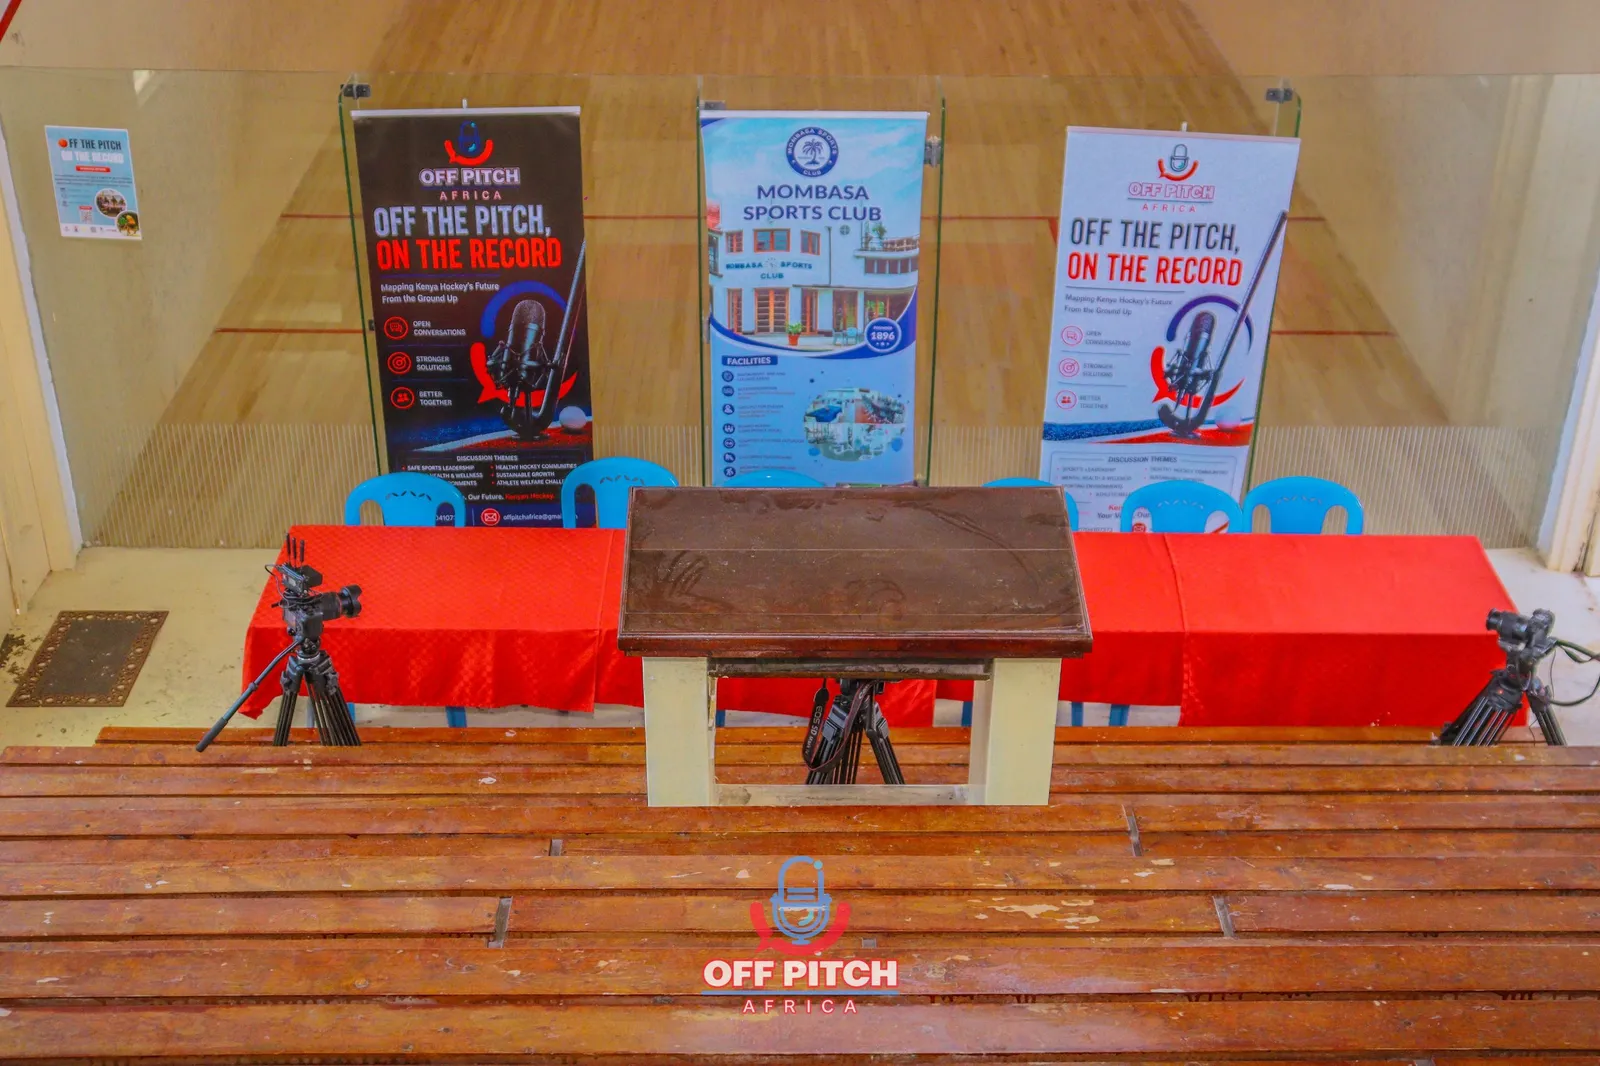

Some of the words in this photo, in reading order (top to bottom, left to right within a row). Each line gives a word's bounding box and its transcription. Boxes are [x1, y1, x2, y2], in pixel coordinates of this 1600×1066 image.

[81, 139, 96, 149] THE
[98, 140, 122, 150] PITCH
[787, 128, 815, 154] MOMBASA
[817, 128, 838, 154] SPORTS
[419, 168, 458, 186] OFF
[461, 167, 521, 186] PITCH
[440, 190, 502, 201] AFRICA
[757, 184, 869, 200] MOMBASA
[1128, 182, 1163, 197] OFF
[1164, 184, 1216, 200] PITCH
[743, 205, 822, 220] SPORTS
[828, 206, 881, 221] CLUB
[1142, 203, 1196, 213] AFRICA
[373, 206, 416, 237] OFF
[423, 205, 469, 236] THE
[475, 204, 552, 238] PITCH,
[1071, 217, 1112, 246] OFF
[1121, 220, 1162, 249] THE
[1170, 223, 1240, 254] PITCH,
[376, 239, 410, 270] ON
[416, 239, 464, 270] THE
[469, 237, 562, 269] RECORD
[780, 262, 812, 270] SPORTS
[1067, 252, 1098, 280] ON
[1107, 254, 1149, 283] THE
[1156, 256, 1243, 286] RECORD
[381, 282, 414, 292] Mapping
[415, 282, 438, 292] Kenya
[440, 282, 473, 292] Hockey's
[475, 282, 499, 291] Future
[382, 295, 401, 304] From
[402, 295, 416, 303] the
[417, 294, 445, 303] Ground
[447, 294, 458, 304] Up
[1065, 294, 1095, 303] Mapping
[1096, 295, 1117, 304] Kenya
[1119, 297, 1150, 306] Hockey's
[1151, 298, 1173, 306] Future
[1064, 305, 1082, 313] From
[1083, 306, 1095, 314] the
[1096, 307, 1120, 315] Ground
[1121, 308, 1132, 316] Up
[870, 331, 895, 341] 1896
[727, 357, 771, 366] FACILITIES
[494, 454, 518, 462] THEMES
[813, 705, 823, 725] EOS
